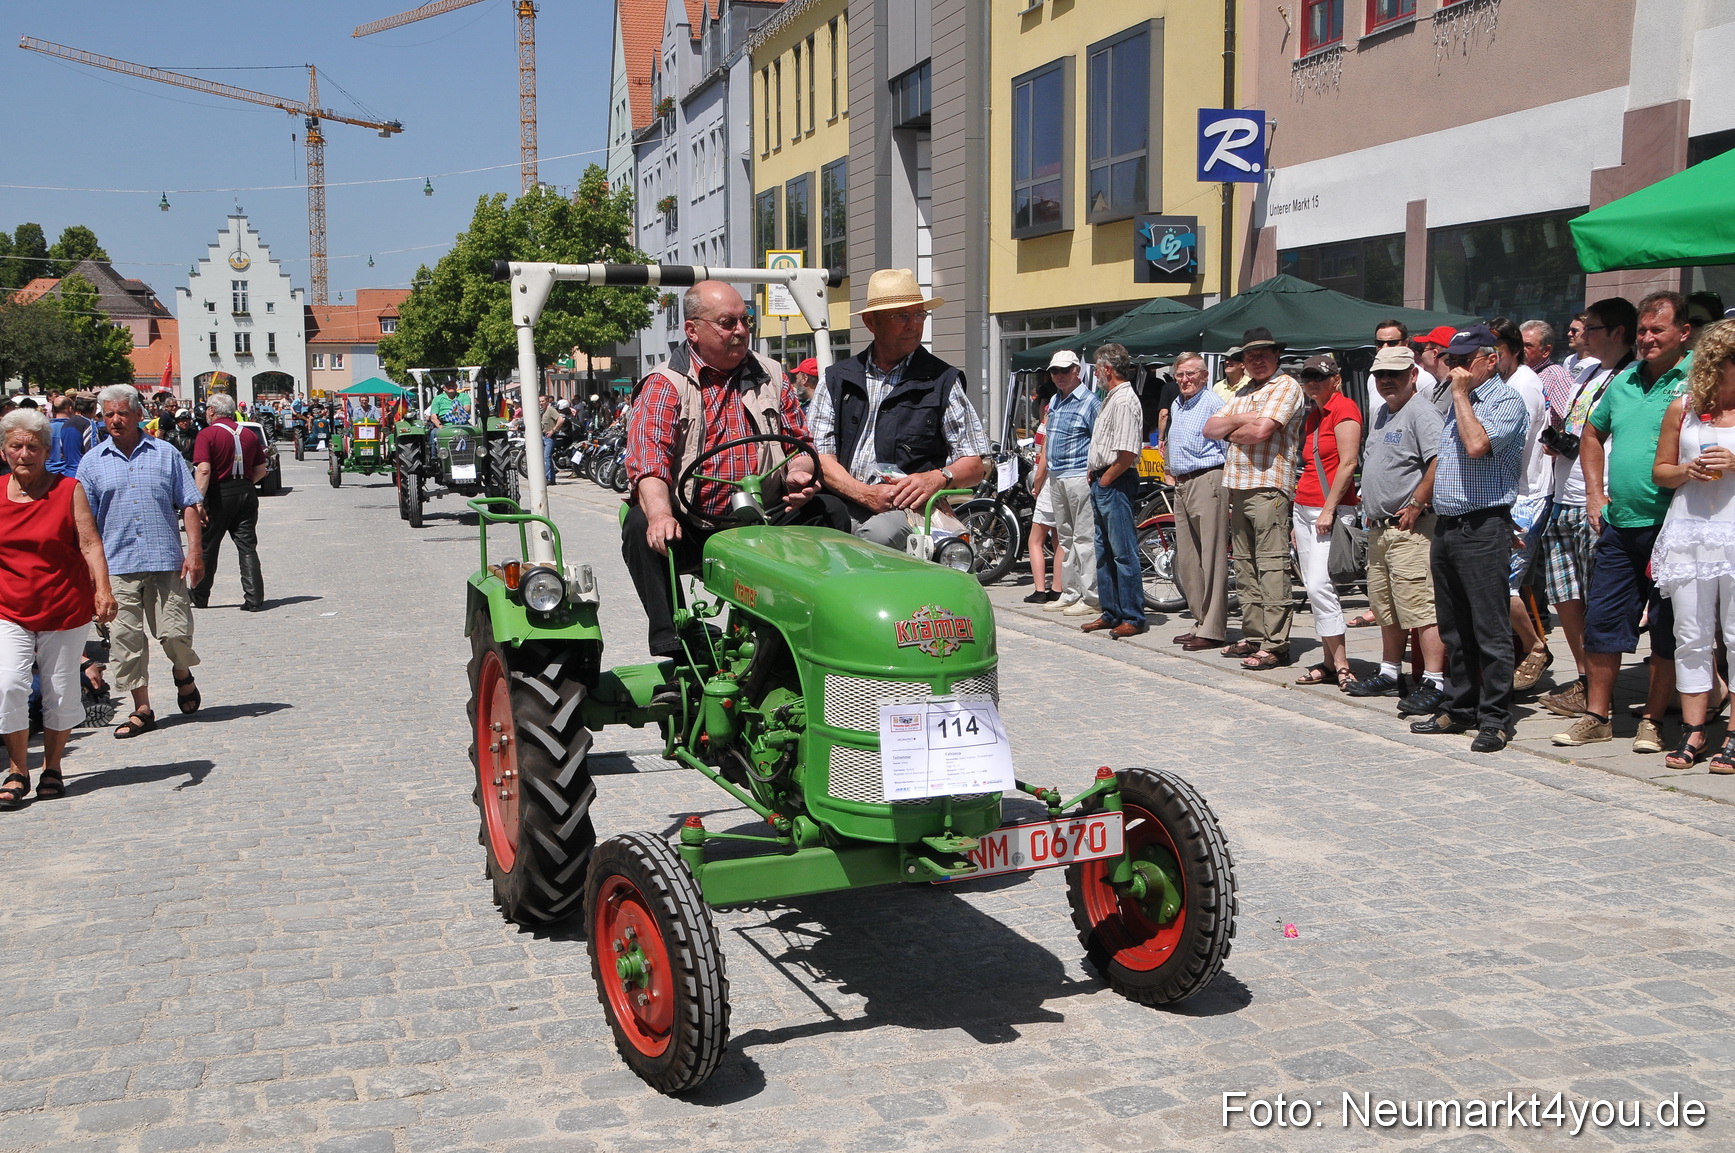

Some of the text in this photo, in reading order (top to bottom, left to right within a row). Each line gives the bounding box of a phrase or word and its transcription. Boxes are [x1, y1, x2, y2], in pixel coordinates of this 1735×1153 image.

[1203, 118, 1261, 173] R.
[1269, 195, 1320, 217] Unterer Markt 15
[1160, 233, 1182, 261] G2
[734, 577, 757, 608] Kramer
[894, 617, 974, 643] Kramer
[938, 716, 980, 738] 114
[968, 821, 1107, 870] NM 0670
